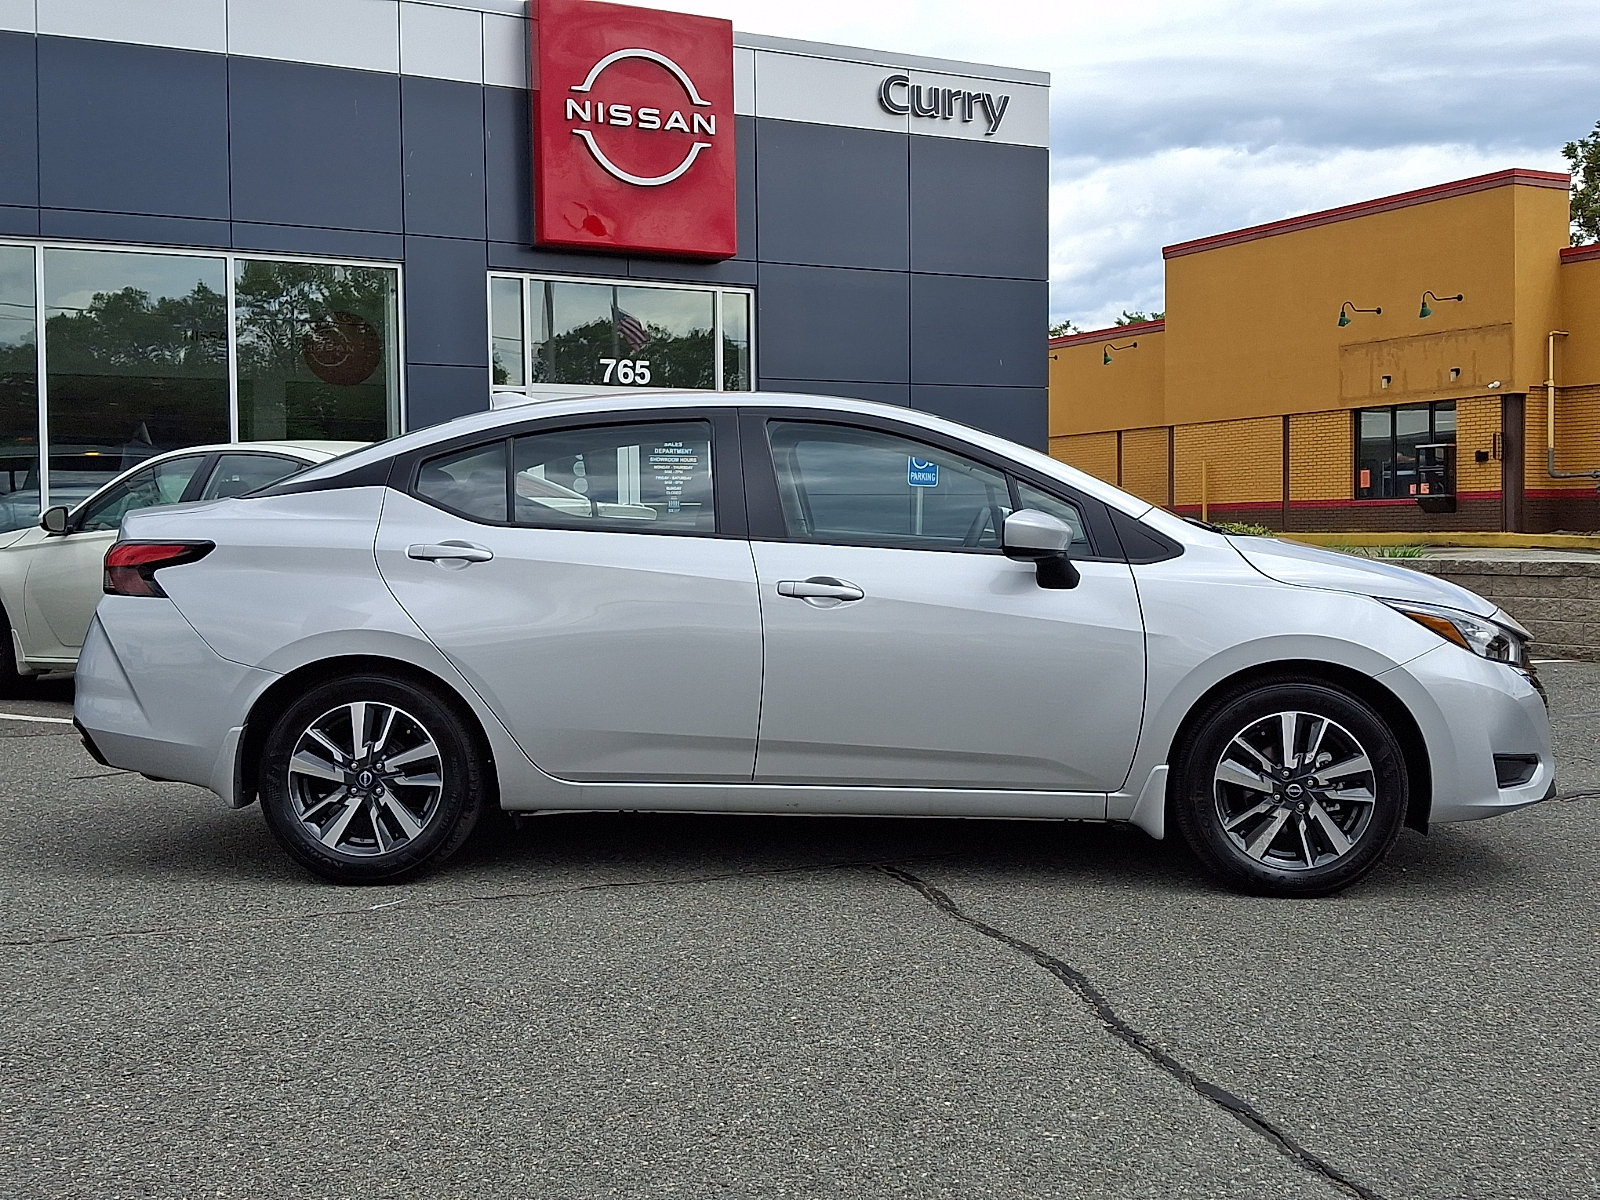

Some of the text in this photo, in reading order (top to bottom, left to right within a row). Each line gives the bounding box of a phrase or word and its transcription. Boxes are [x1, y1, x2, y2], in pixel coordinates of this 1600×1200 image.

[566, 97, 717, 136] NISSAN
[879, 73, 1010, 136] Curry
[599, 358, 651, 385] 765
[910, 472, 936, 482] PARKING
